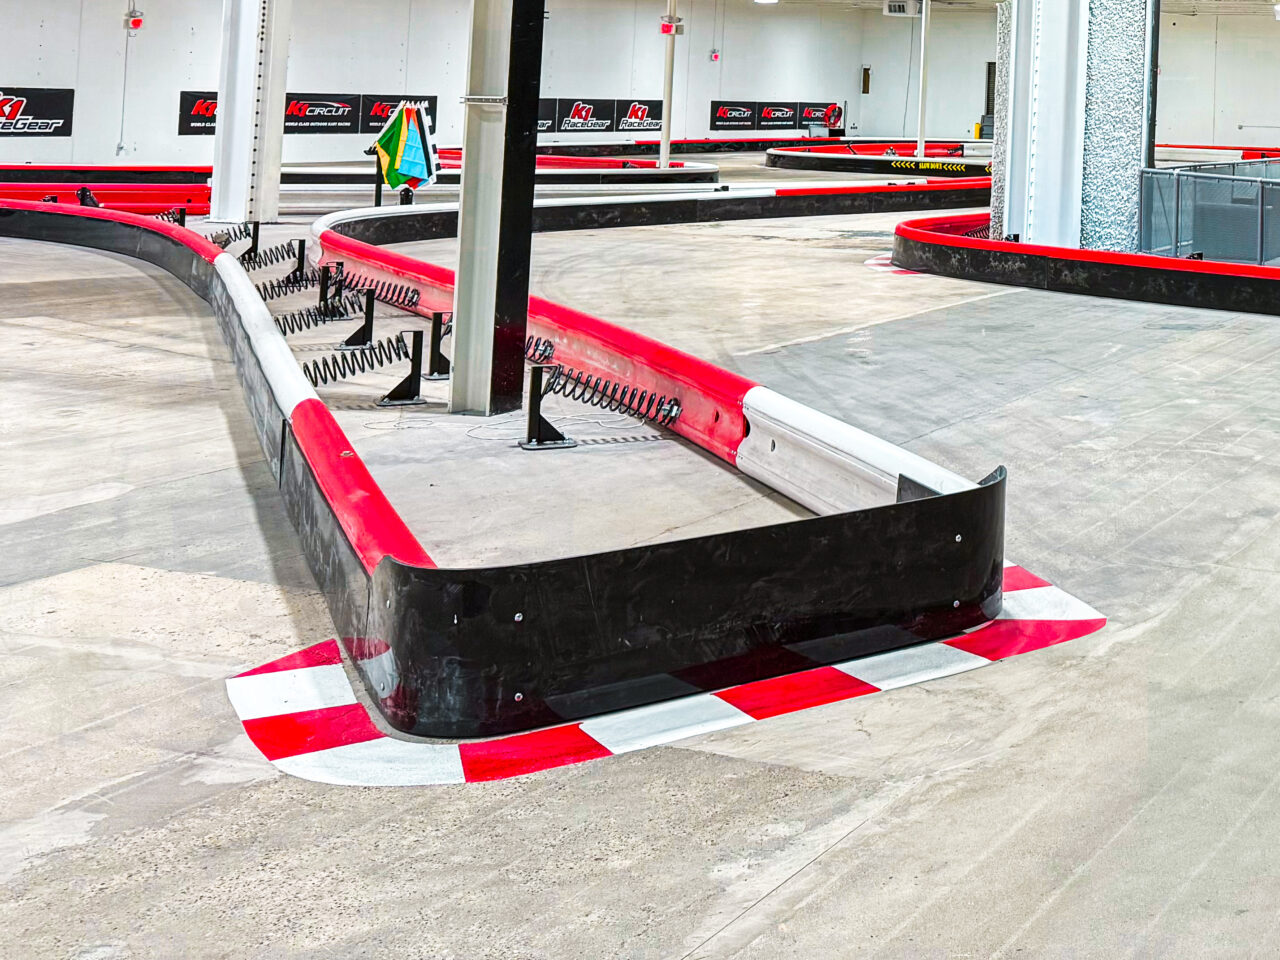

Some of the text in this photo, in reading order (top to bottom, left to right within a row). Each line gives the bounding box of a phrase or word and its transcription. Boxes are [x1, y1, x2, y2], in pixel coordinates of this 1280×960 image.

[191, 99, 217, 117] K1
[286, 100, 352, 117] K1 CIRCUIT
[370, 101, 390, 118] K1
[571, 102, 593, 121] K1
[628, 103, 648, 121] K1
[0, 116, 64, 132] eGear
[561, 119, 610, 130] RaceGear
